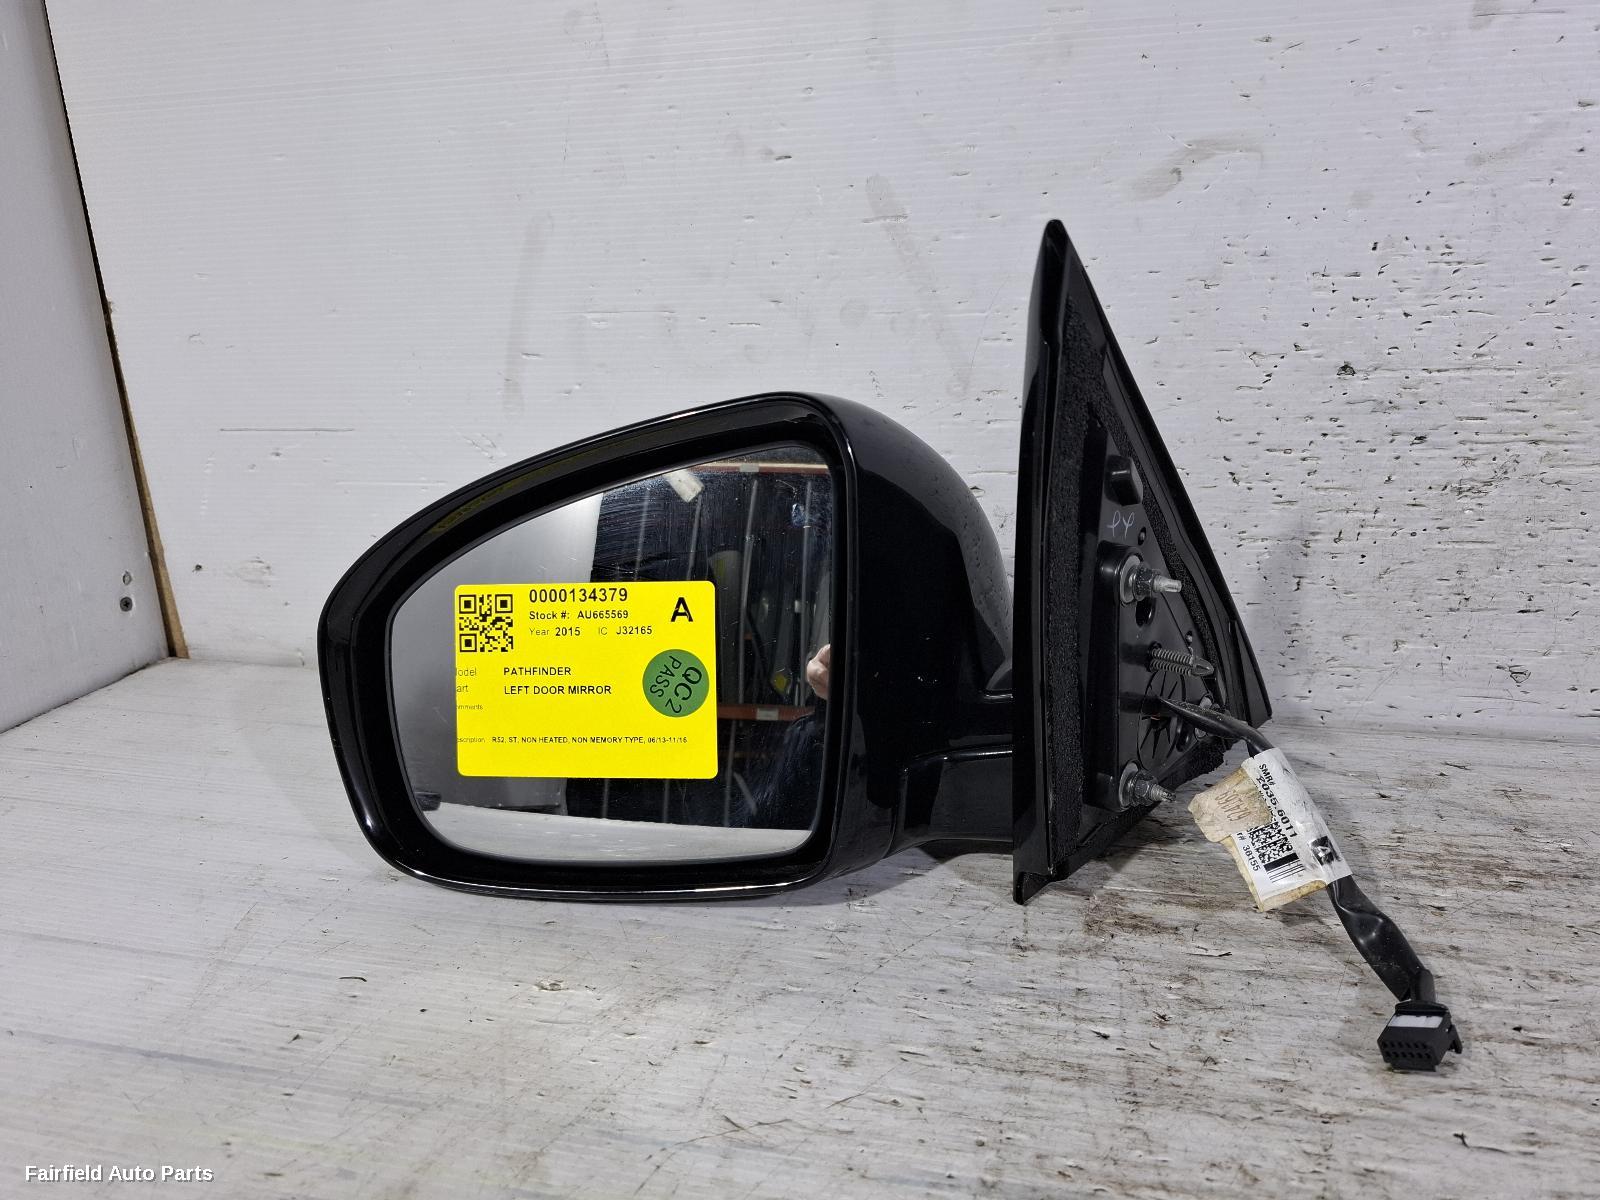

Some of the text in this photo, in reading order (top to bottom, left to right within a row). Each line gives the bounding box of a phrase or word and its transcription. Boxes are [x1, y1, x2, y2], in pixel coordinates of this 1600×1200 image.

[529, 588, 628, 603] 0000134379
[670, 597, 693, 622] A
[529, 610, 629, 620] Stock #: AU665569
[529, 626, 653, 636] Year 2015 IC J32165
[503, 667, 572, 676] PATHFINDER
[650, 655, 682, 697] PASS
[504, 686, 530, 695] LEFT
[533, 686, 566, 695] DOOR
[568, 686, 613, 695] MIRROR
